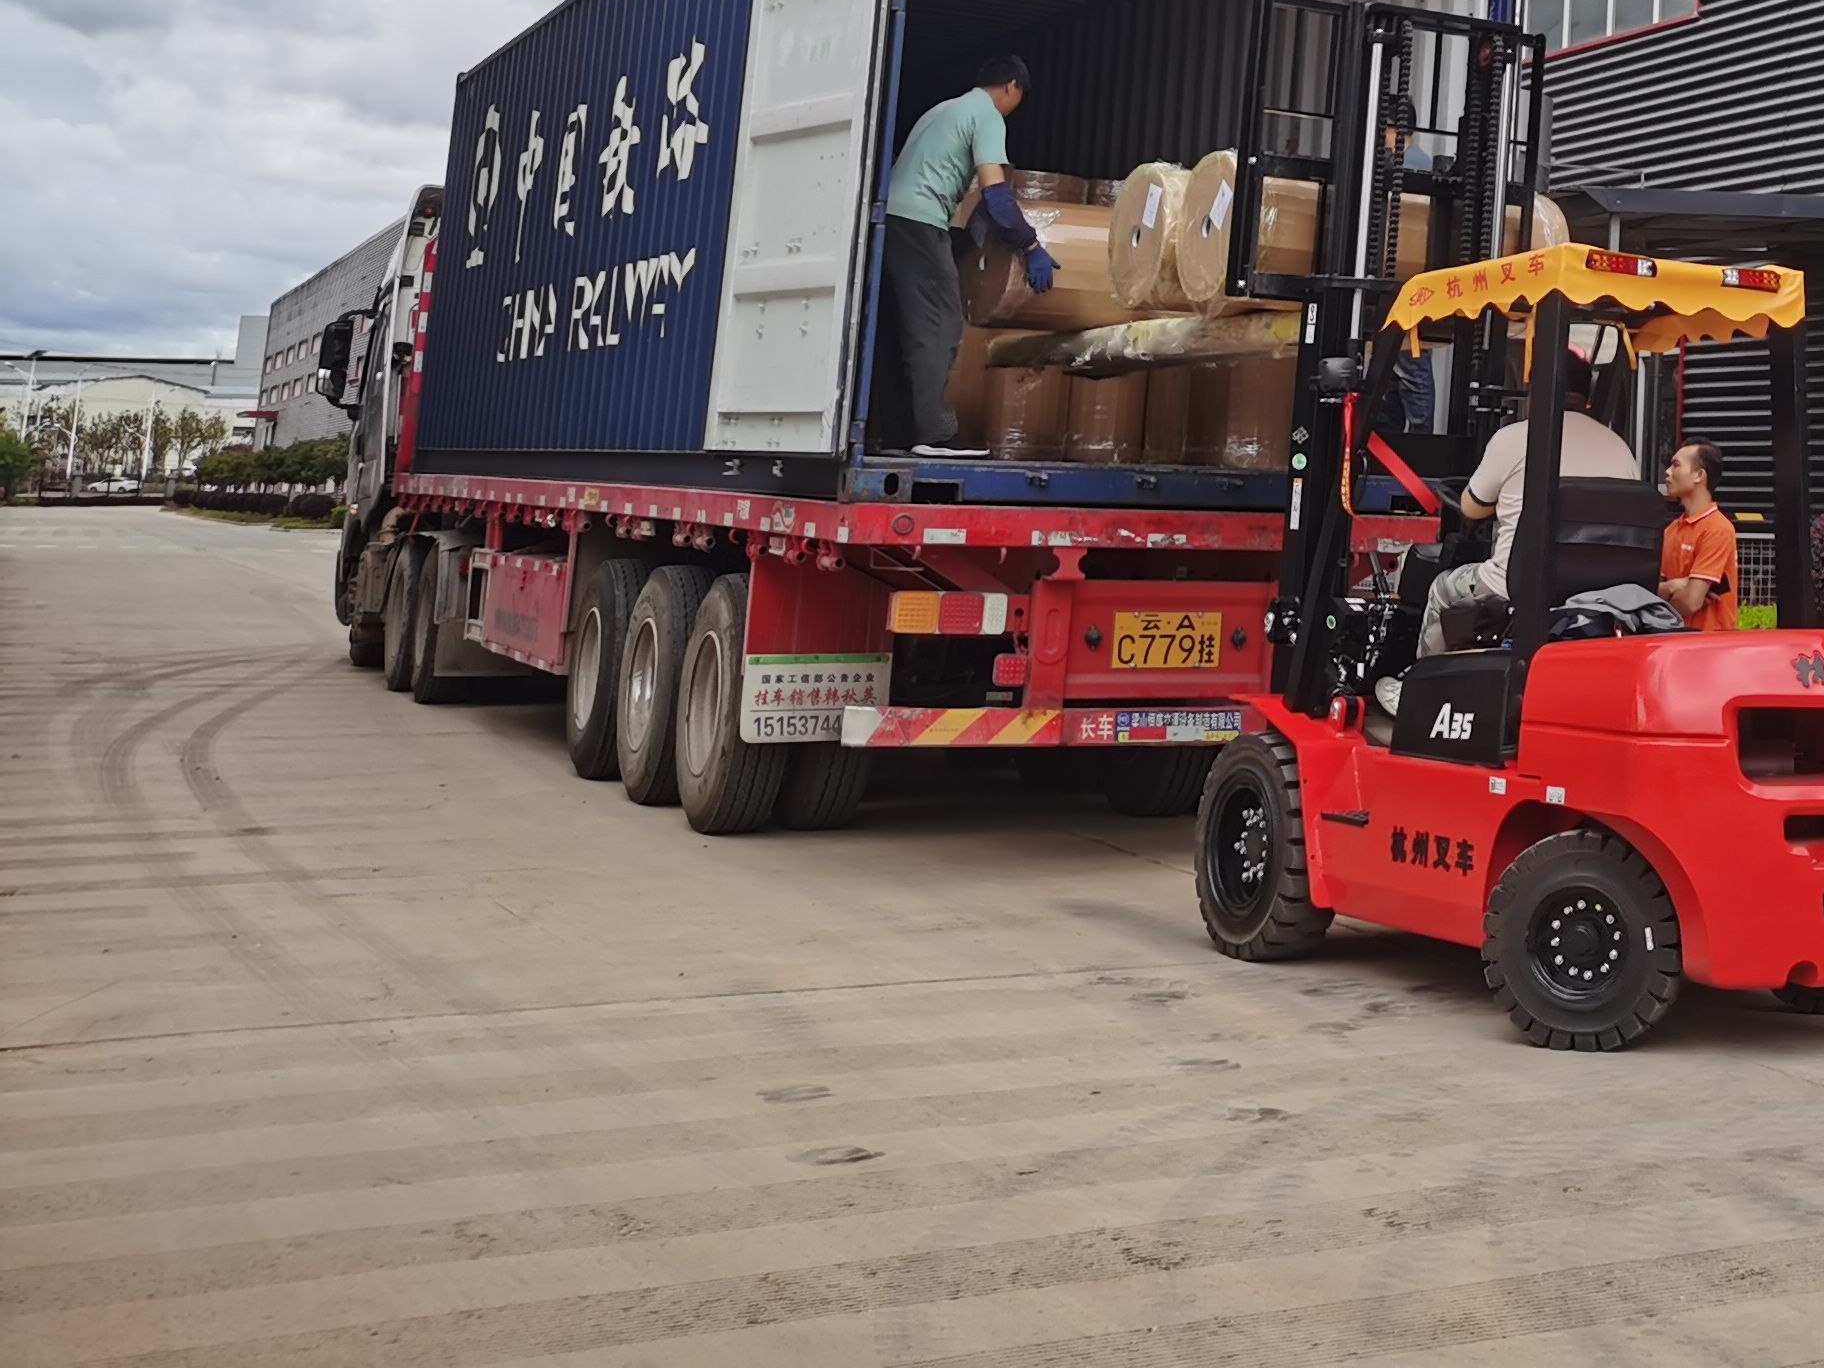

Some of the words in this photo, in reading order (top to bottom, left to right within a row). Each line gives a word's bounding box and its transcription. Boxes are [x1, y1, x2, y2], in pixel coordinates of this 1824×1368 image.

[1446, 254, 1545, 299] 杭州叉车
[1117, 634, 1216, 665] C779挂
[762, 673, 875, 684] 国家工信部公告企业
[1081, 714, 1115, 740] 长车
[1429, 702, 1475, 740] A35
[1390, 825, 1475, 877] 杭州叉车
